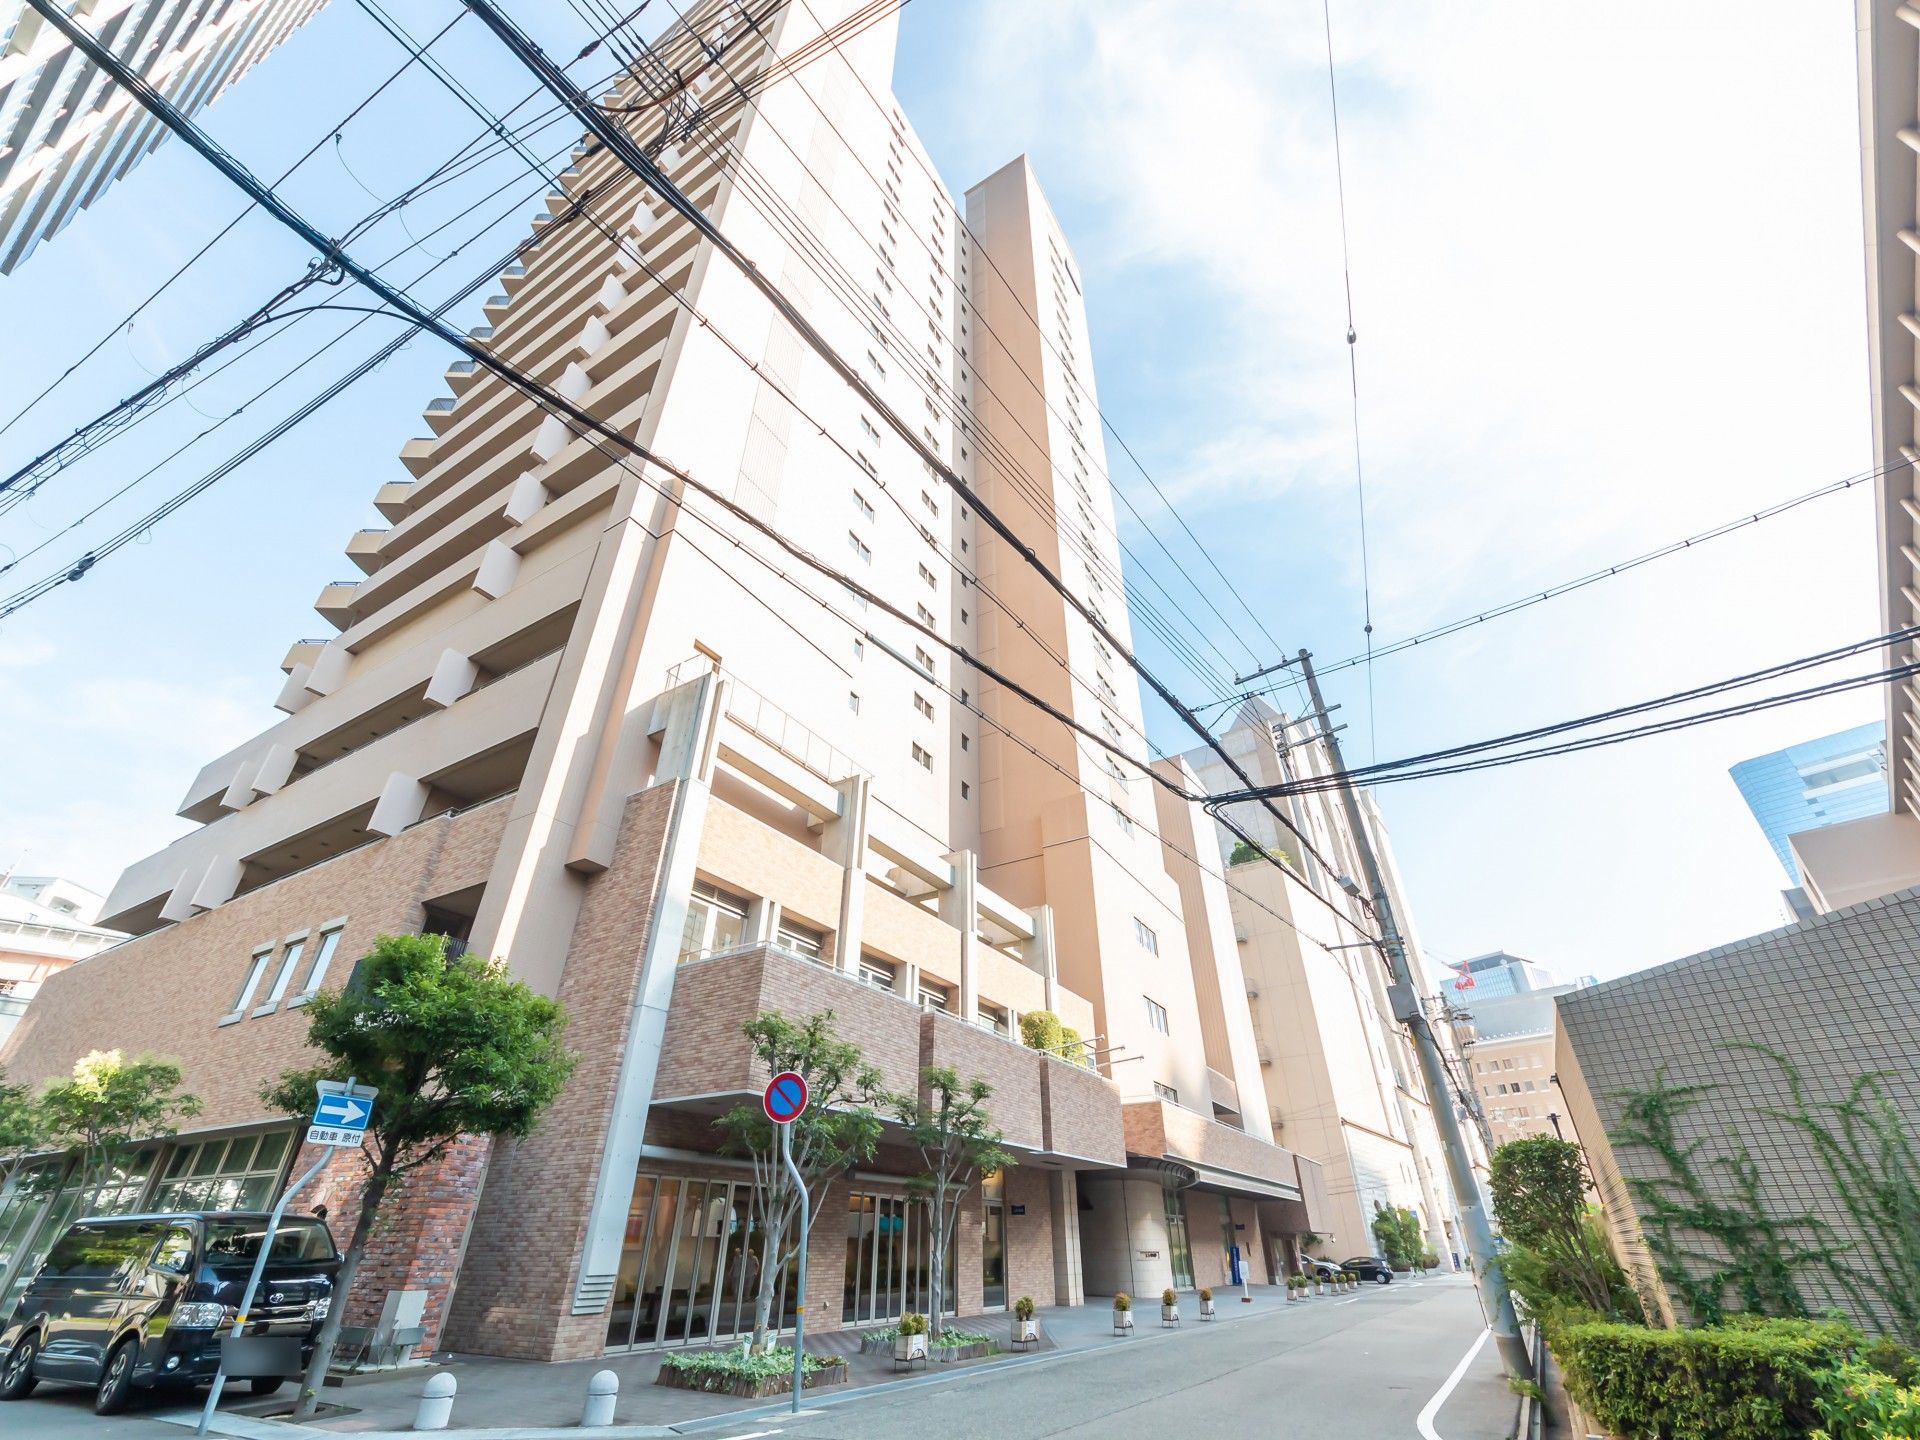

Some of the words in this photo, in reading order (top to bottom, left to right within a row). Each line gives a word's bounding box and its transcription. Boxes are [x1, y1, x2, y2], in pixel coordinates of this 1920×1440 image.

[310, 1130, 338, 1141] 自動車
[341, 1133, 360, 1143] 原付
